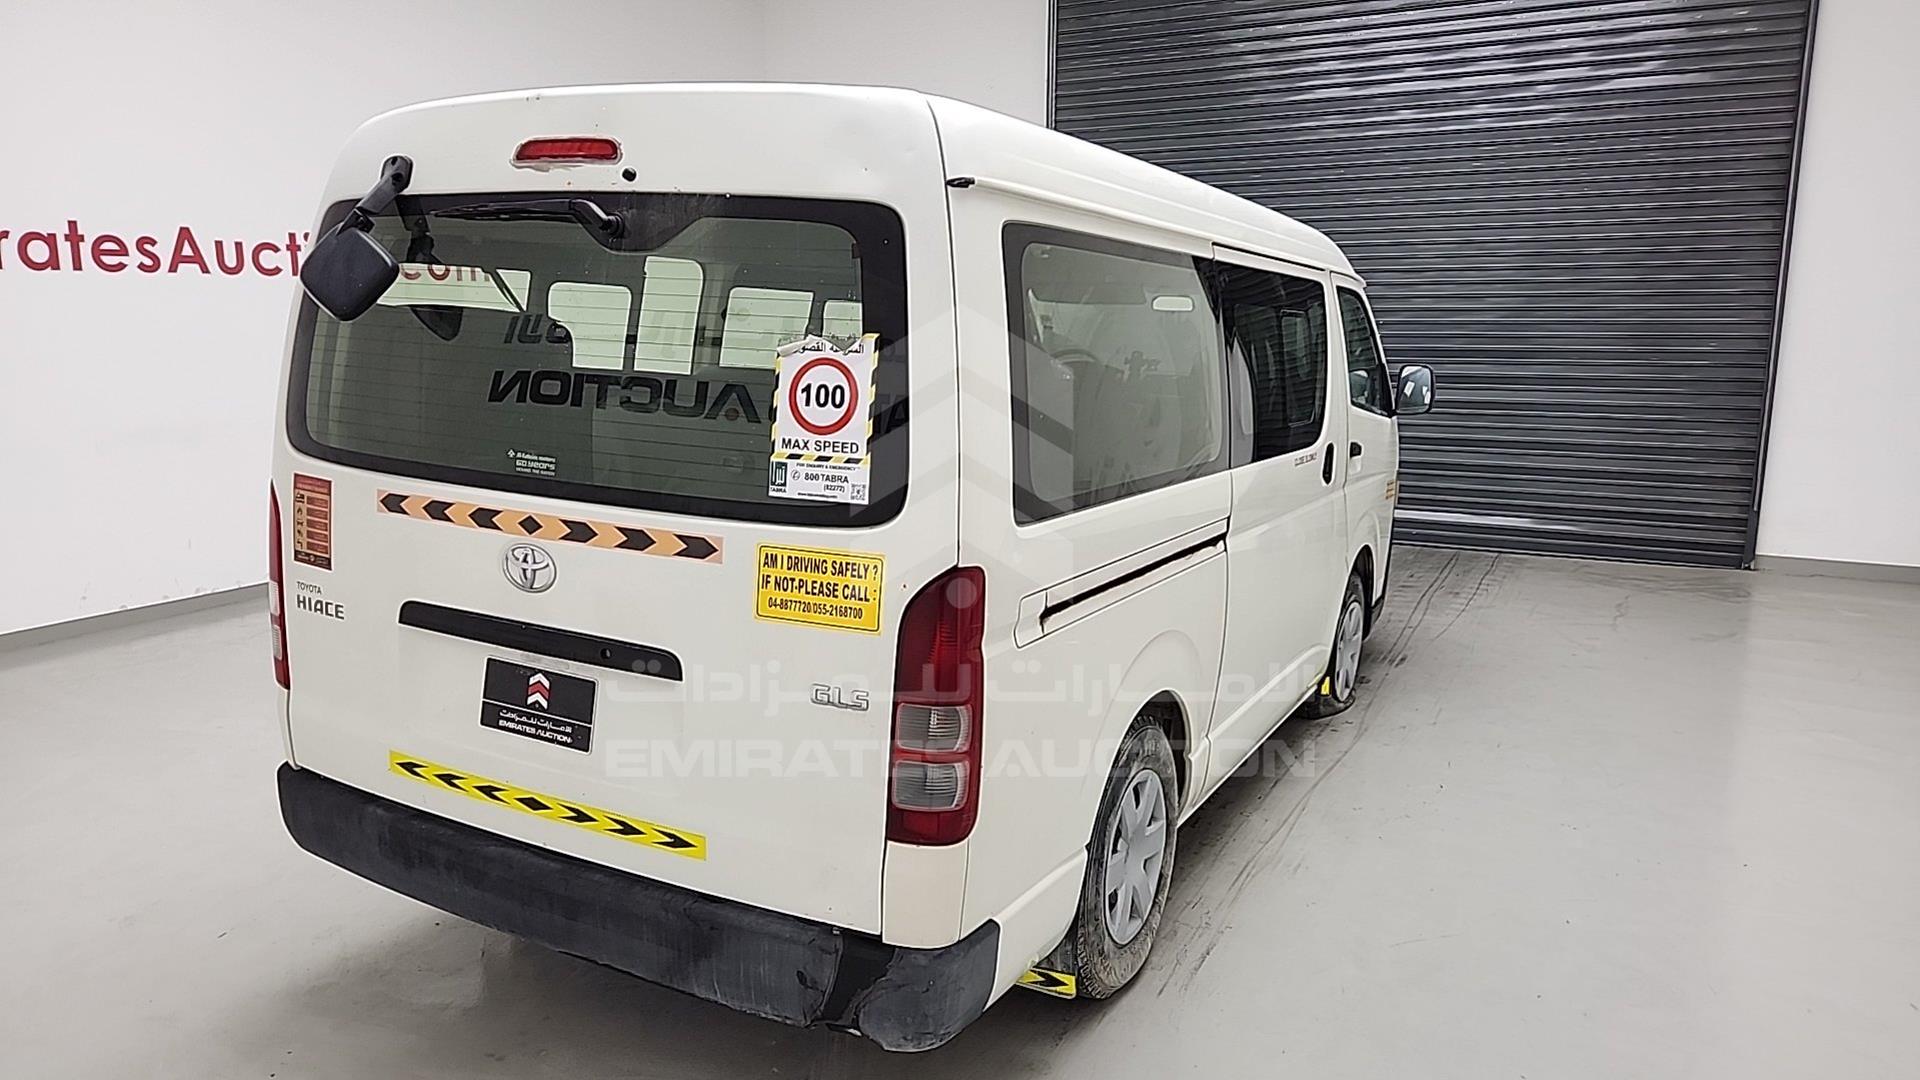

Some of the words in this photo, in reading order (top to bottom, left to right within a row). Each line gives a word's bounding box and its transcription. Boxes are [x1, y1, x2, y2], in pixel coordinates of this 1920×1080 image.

[800, 382, 846, 410] 100
[781, 437, 810, 451] MAX
[814, 440, 859, 454] SPEED
[804, 472, 820, 481] 800
[820, 473, 849, 484] TABRA
[763, 552, 778, 569] AM
[780, 554, 784, 570] I
[786, 555, 828, 575] DRIVING
[830, 560, 870, 580] SAFELY
[297, 581, 322, 595] TOYOTA
[761, 573, 771, 590] IF
[842, 584, 871, 602] CALL
[296, 594, 345, 620] HIACE
[810, 683, 869, 712] GLS
[498, 719, 537, 734] EMIRATES
[536, 729, 573, 744] AUCTION
